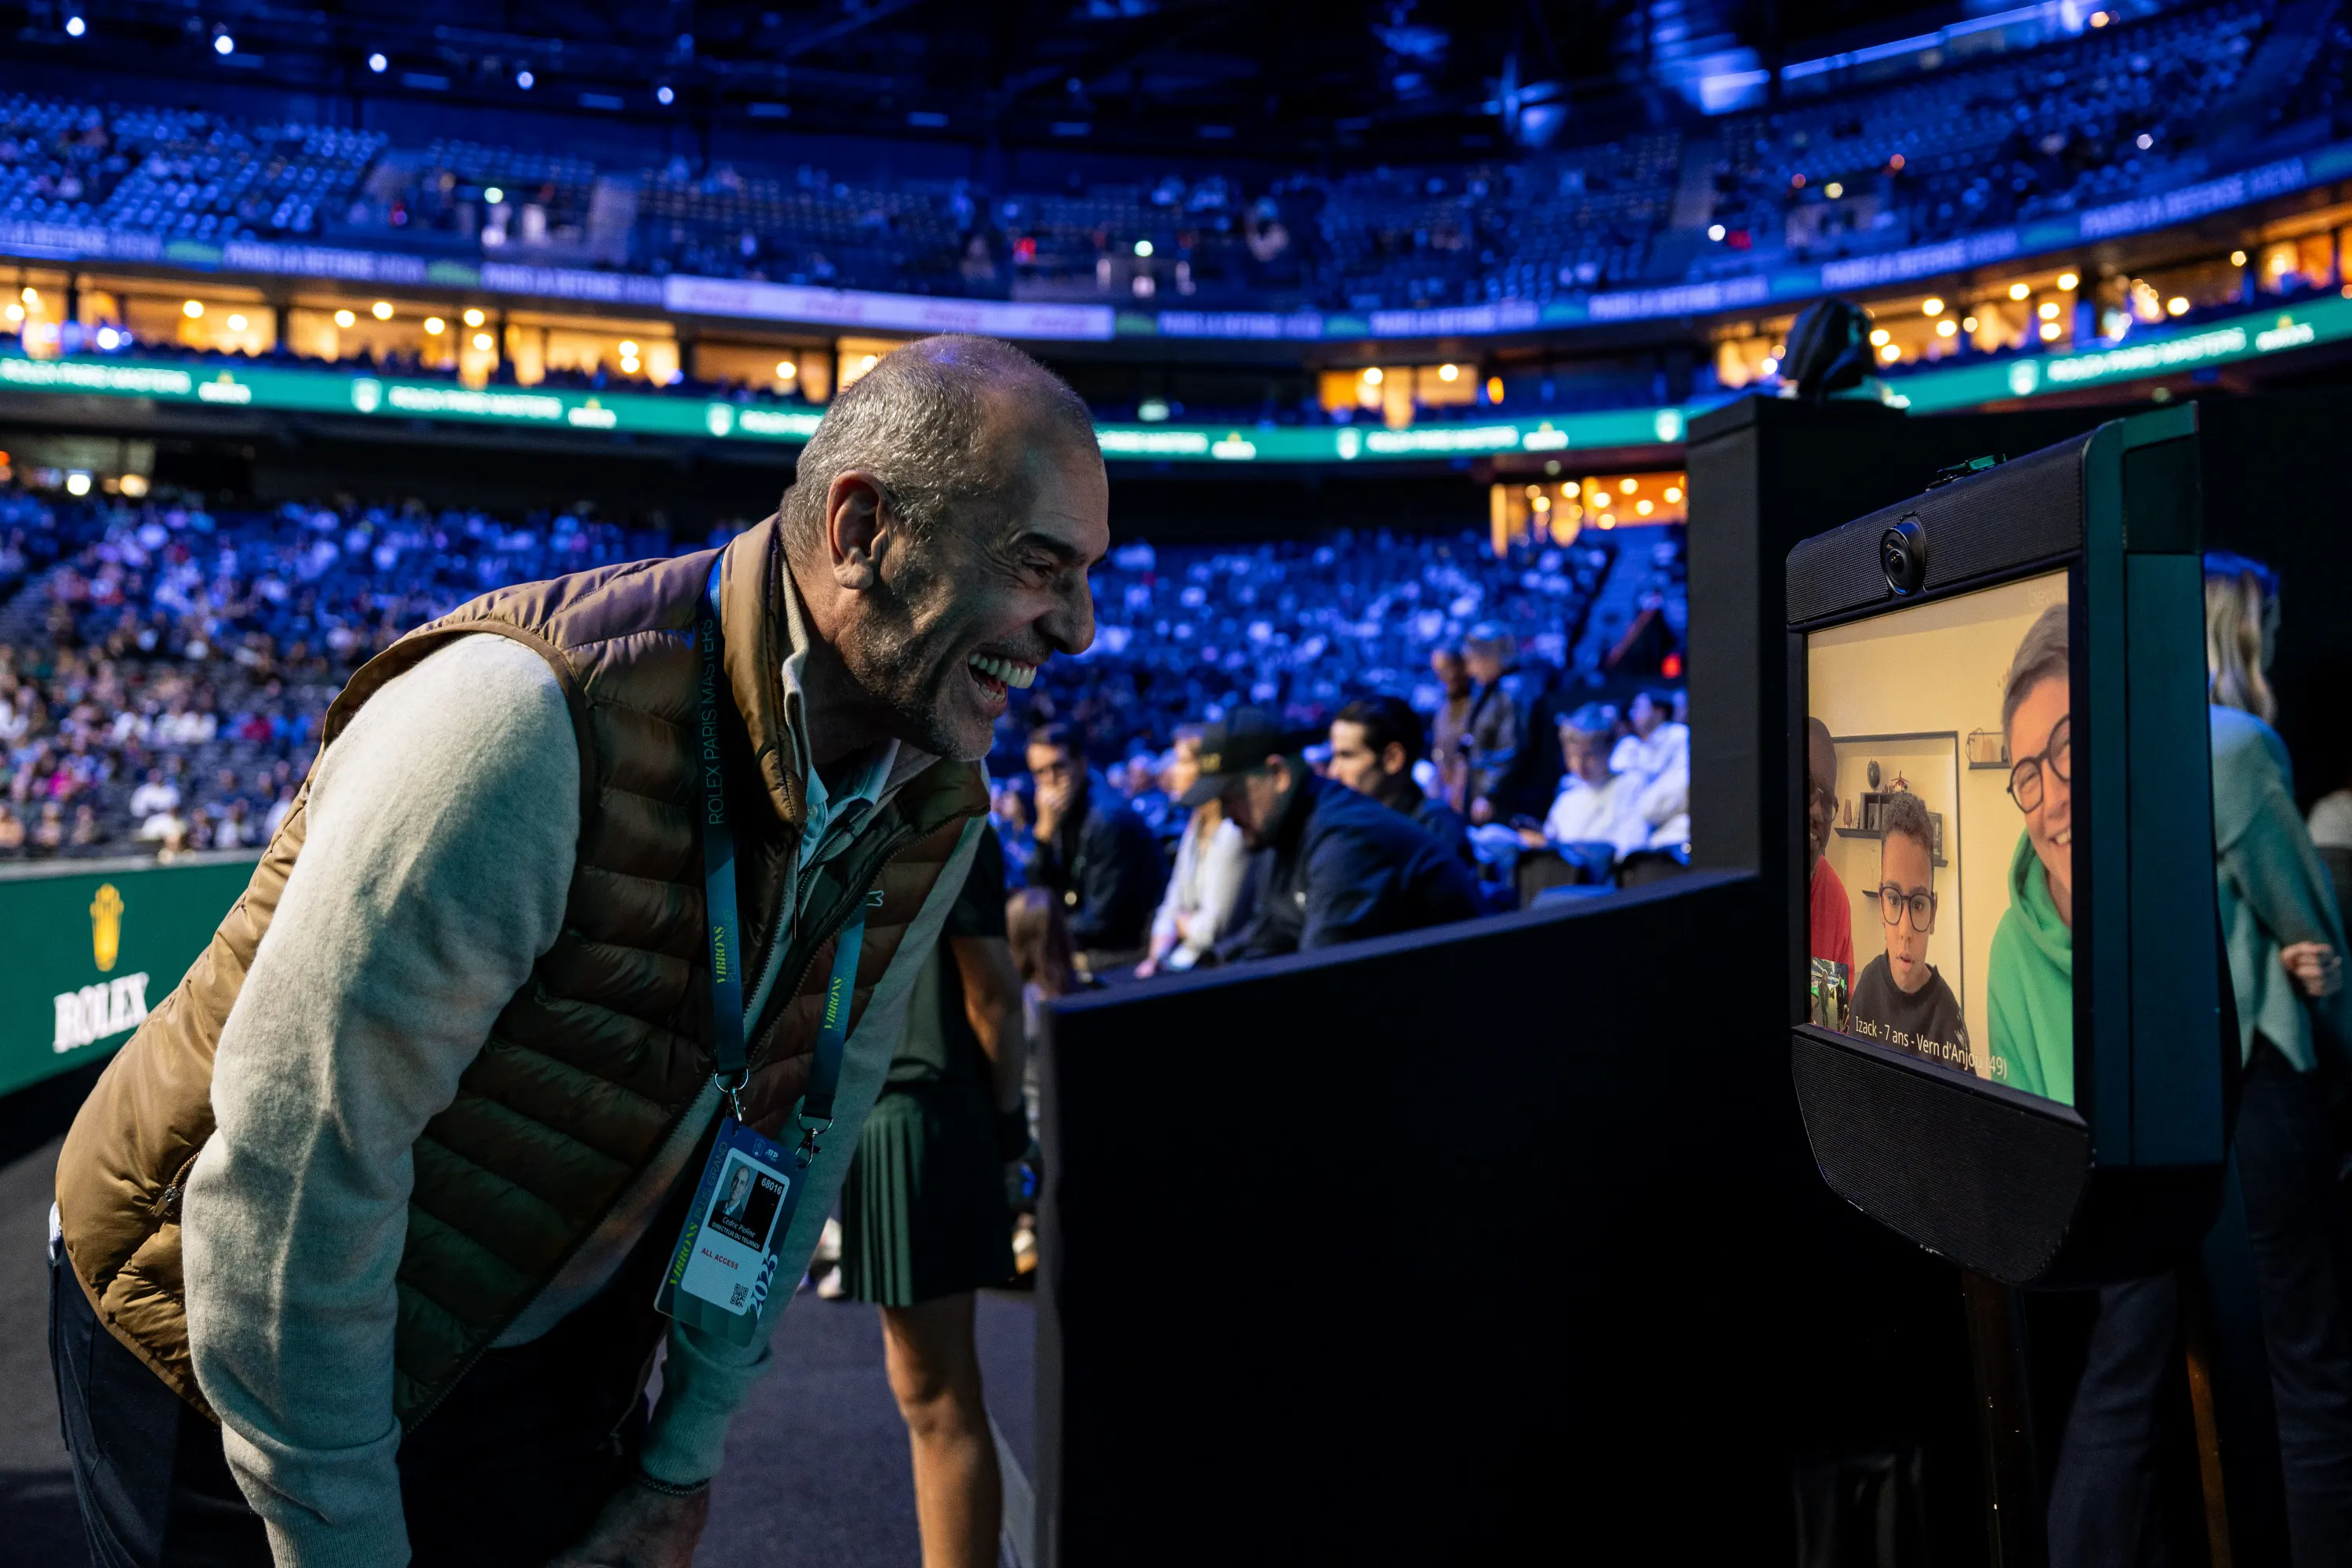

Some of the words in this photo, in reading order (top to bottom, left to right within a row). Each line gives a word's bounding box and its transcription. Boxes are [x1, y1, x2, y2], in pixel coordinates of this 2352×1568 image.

[702, 709, 720, 760] PARIS
[706, 765, 724, 824] ROLEX
[714, 926, 726, 983] VIBRONS
[53, 971, 150, 1054] ROLEX
[824, 976, 842, 1029] VIBRONS
[1855, 1015, 1878, 1038] Izack
[1884, 1024, 1890, 1041] 7
[1892, 1030, 1909, 1047] ans
[1916, 1033, 1940, 1057] Vern
[1942, 1040, 1982, 1071] d'Anjou
[1985, 1054, 2007, 1080] (49)
[669, 1220, 699, 1285] VIBRONS
[694, 1188, 712, 1220] PLUS
[706, 1141, 728, 1187] GRAND
[761, 1178, 782, 1195] 68016
[712, 1221, 735, 1237] DIRECTEUR
[741, 1236, 760, 1250] TOURNOI
[722, 1216, 739, 1229] Cedric
[738, 1224, 756, 1238] Pioline
[701, 1247, 713, 1258] ALL
[714, 1254, 739, 1270] ACCESS
[749, 1249, 779, 1321] 2025
